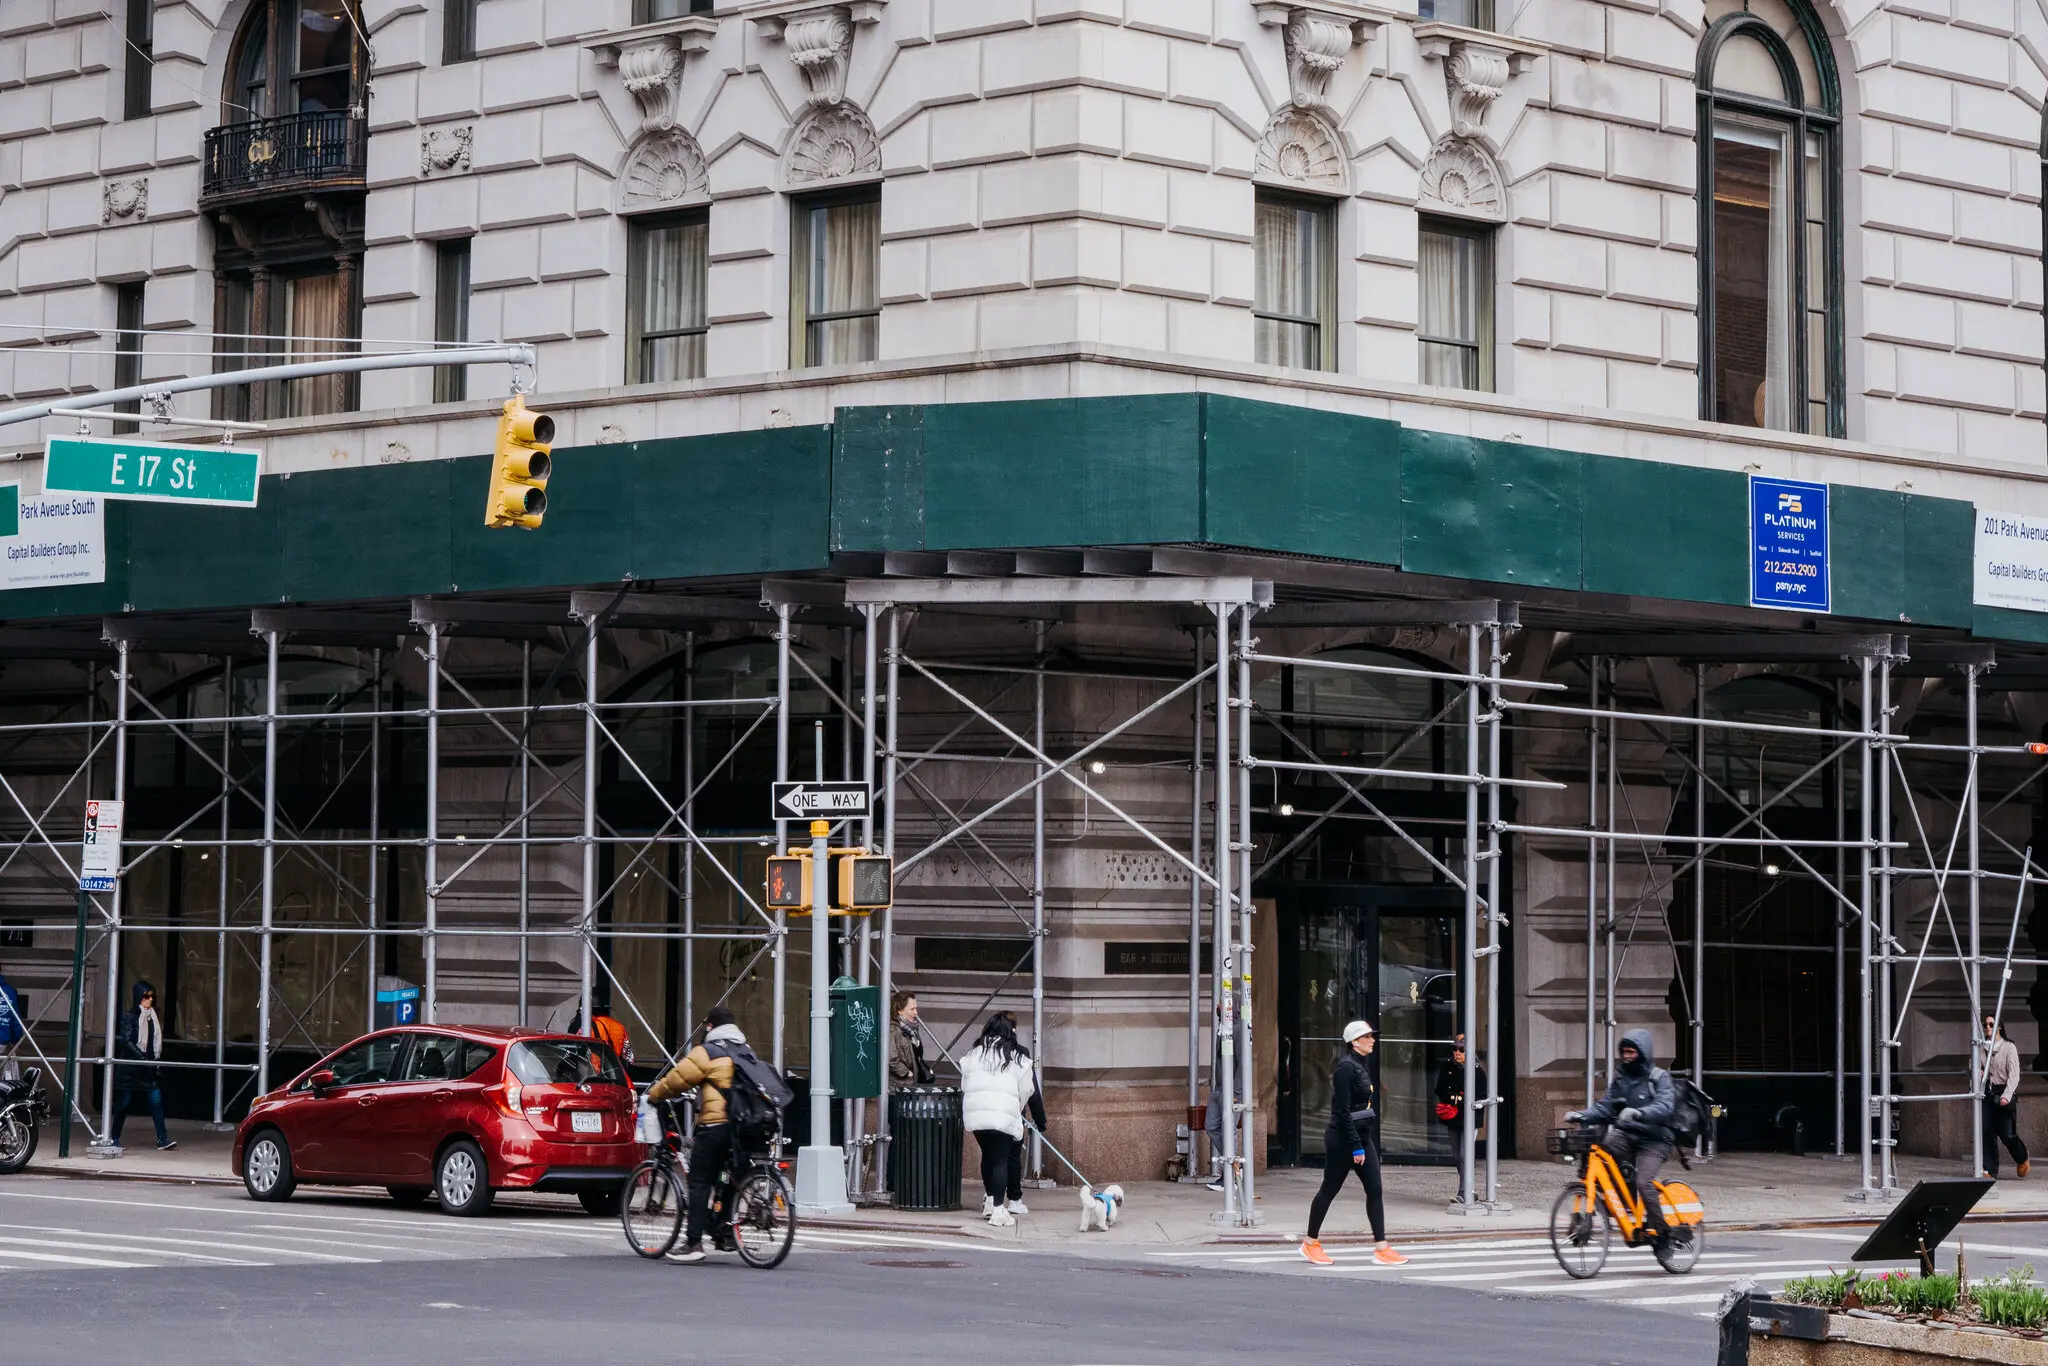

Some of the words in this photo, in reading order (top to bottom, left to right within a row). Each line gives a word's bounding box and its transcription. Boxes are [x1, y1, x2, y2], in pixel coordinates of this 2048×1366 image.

[111, 453, 127, 485] E
[138, 455, 161, 487] 17
[169, 457, 196, 489] St
[21, 501, 38, 519] Park
[40, 501, 70, 518] Avenue
[72, 497, 96, 515] South
[1764, 513, 1816, 529] PLATINUM
[1984, 517, 1998, 535] 201
[2001, 519, 2018, 538] Park
[1777, 531, 1804, 541] SERVICES
[7, 545, 29, 563] Capital
[30, 542, 56, 558] Builders
[57, 542, 77, 557] Group
[78, 541, 90, 554] Inc.
[1764, 560, 1817, 577] 212.253.2900
[1988, 561, 2010, 579] Capital
[2012, 563, 2037, 580] Builders
[1775, 581, 1807, 594] psny.nyc
[792, 794, 818, 807] ONE
[831, 793, 860, 807] WAY
[87, 832, 94, 844] 2
[1120, 951, 1136, 964] BAR
[402, 1003, 412, 1020] P
